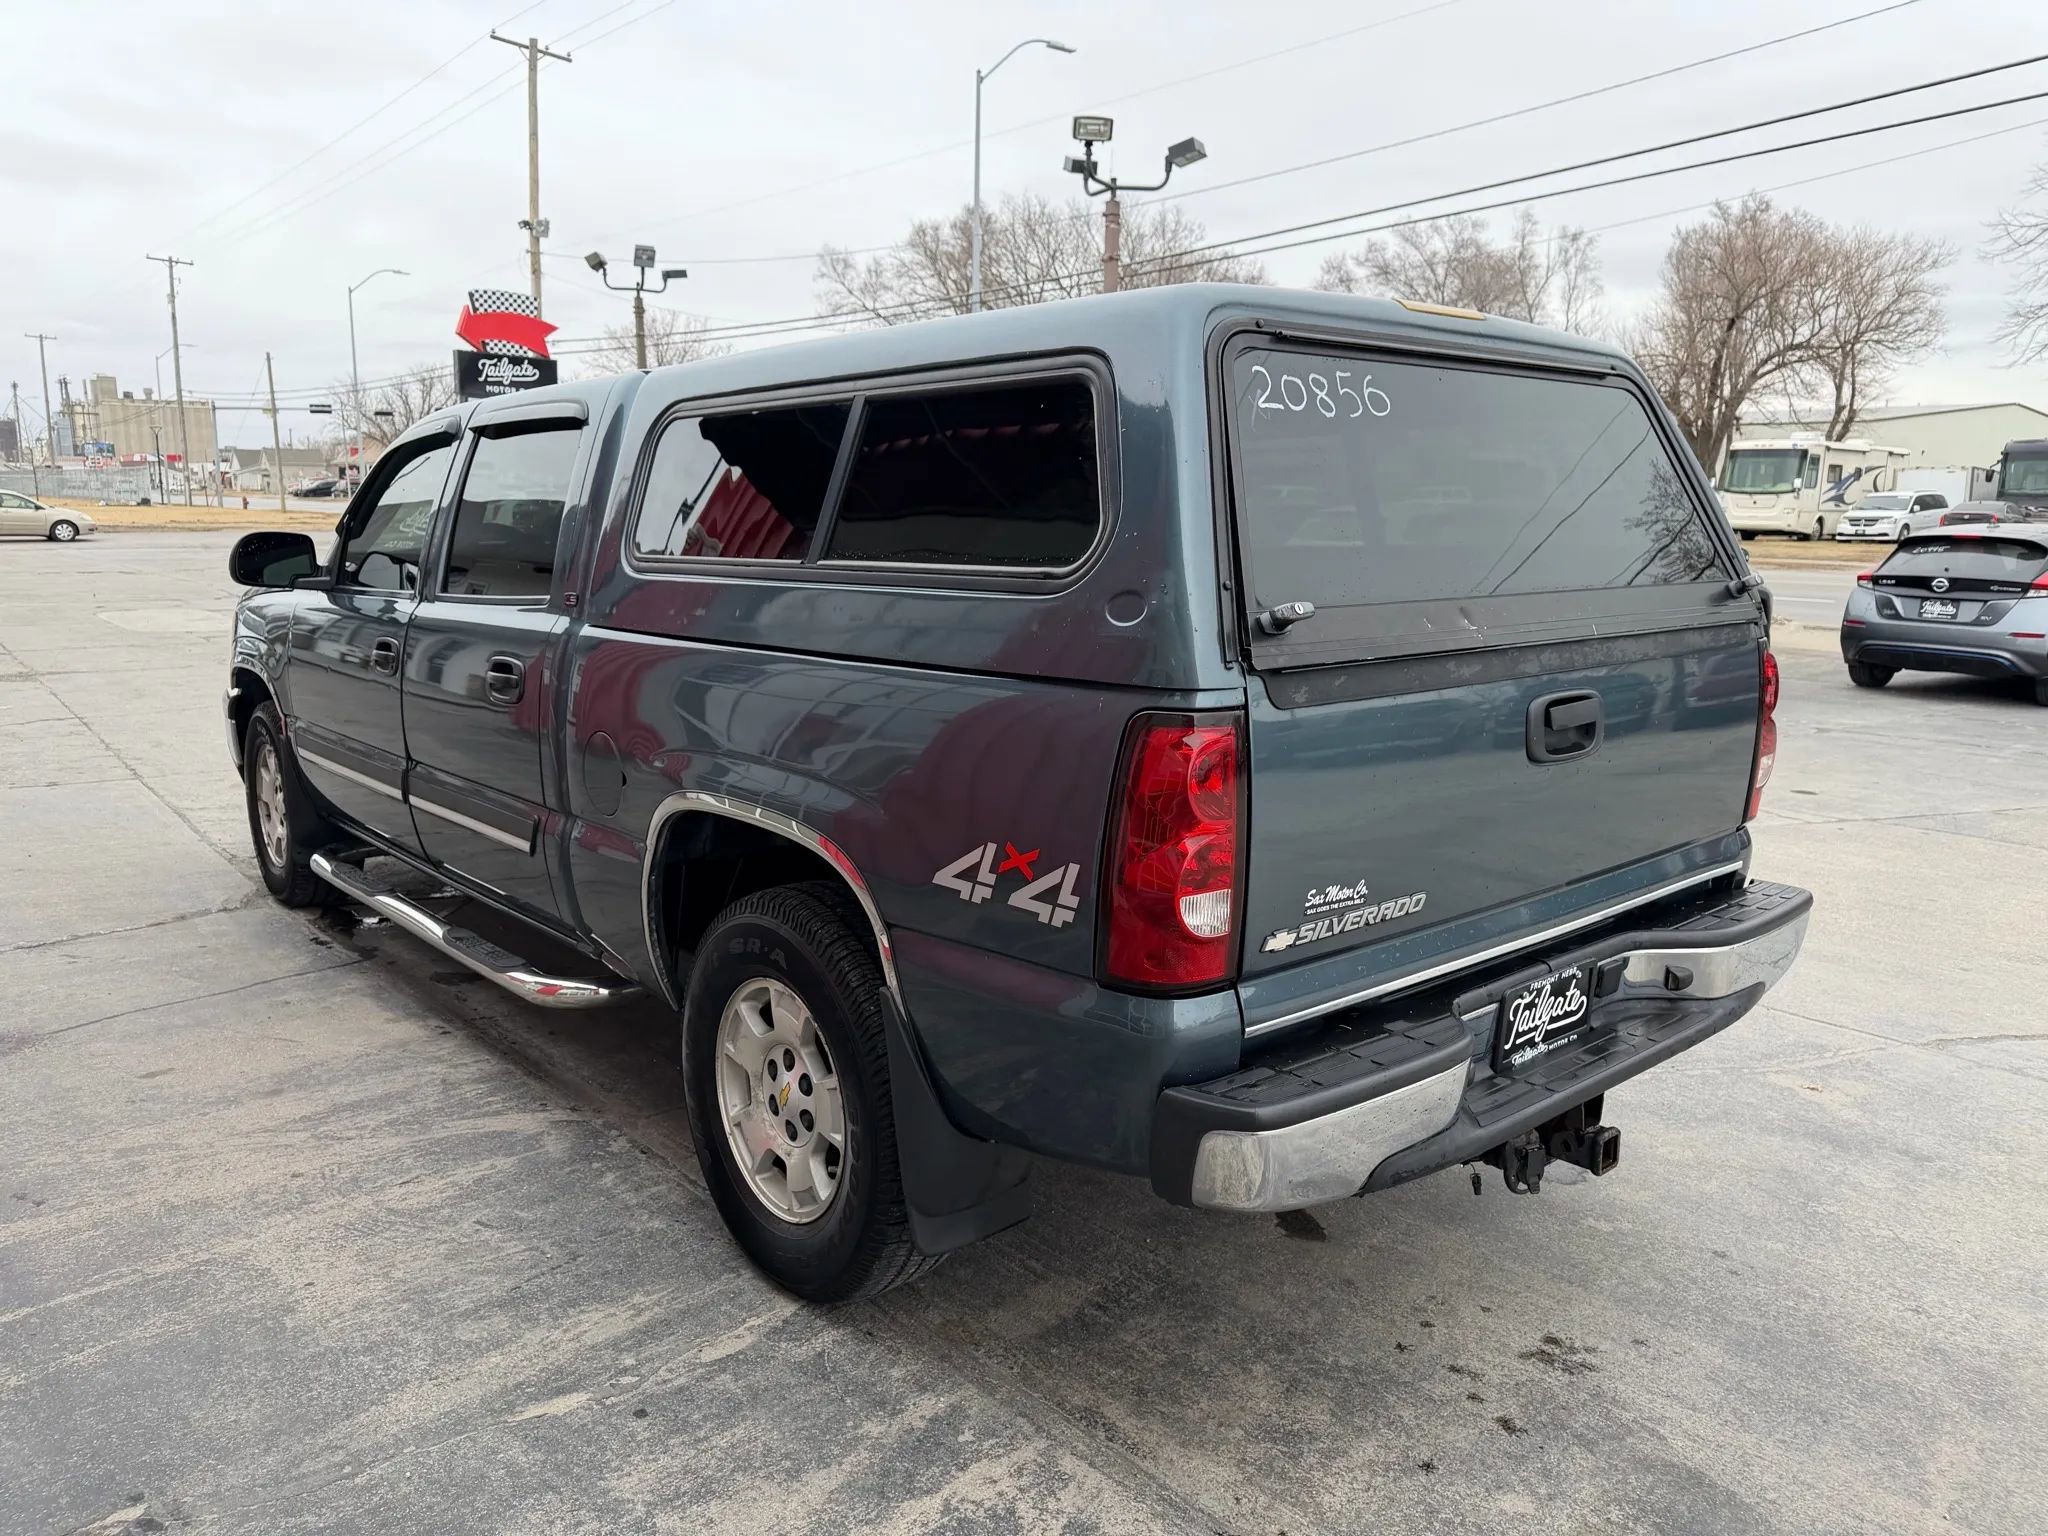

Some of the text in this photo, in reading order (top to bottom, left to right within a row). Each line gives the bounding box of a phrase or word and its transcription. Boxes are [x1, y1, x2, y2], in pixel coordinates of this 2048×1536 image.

[478, 357, 540, 385] Tailgate
[486, 385, 517, 394] MOTOR
[1252, 366, 1391, 418] 20856
[1304, 879, 1369, 907] Sax Motor Co.
[1330, 902, 1339, 910] THE
[1295, 891, 1428, 946] SILVERADO
[1530, 974, 1560, 991] FREMONT
[1504, 979, 1588, 1050] Tailgate
